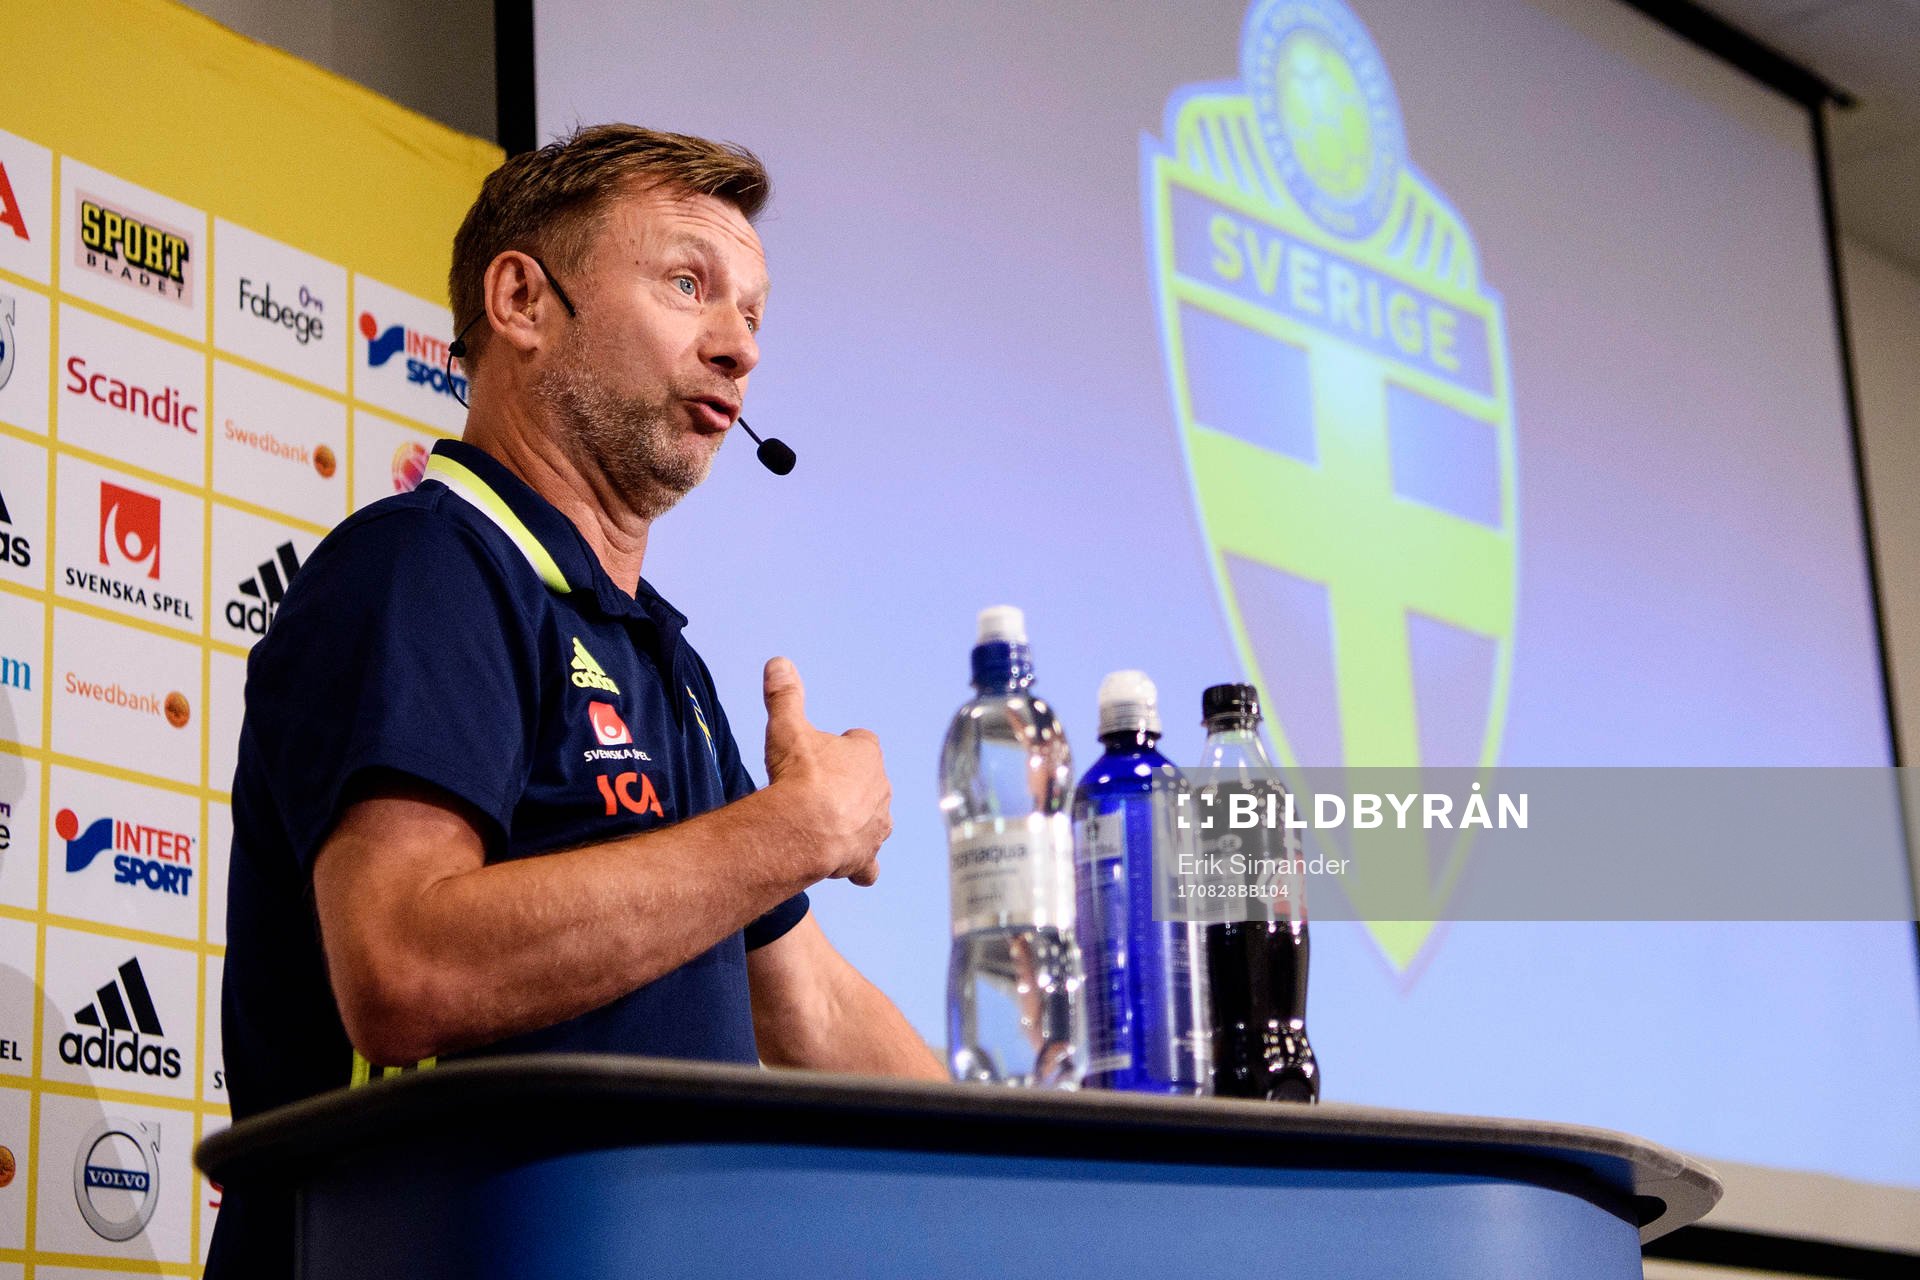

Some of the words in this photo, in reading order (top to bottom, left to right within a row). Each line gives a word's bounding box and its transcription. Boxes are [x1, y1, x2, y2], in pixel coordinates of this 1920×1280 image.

[81, 200, 189, 284] SPORT
[87, 253, 184, 299] BLADET
[1209, 213, 1461, 373] SVERIGE
[239, 277, 324, 345] Fabege
[66, 355, 198, 434] Scandic
[224, 419, 310, 466] Swedbank
[65, 567, 147, 607] SVENSKA
[152, 592, 194, 621] SPEL
[65, 671, 162, 717] Swedbank
[583, 748, 633, 762] SVENSKA
[596, 771, 665, 818] ICA
[115, 820, 191, 865] INTER
[114, 854, 193, 896] SPORT
[59, 1026, 182, 1079] adidas
[88, 1168, 147, 1189] VOLVO
